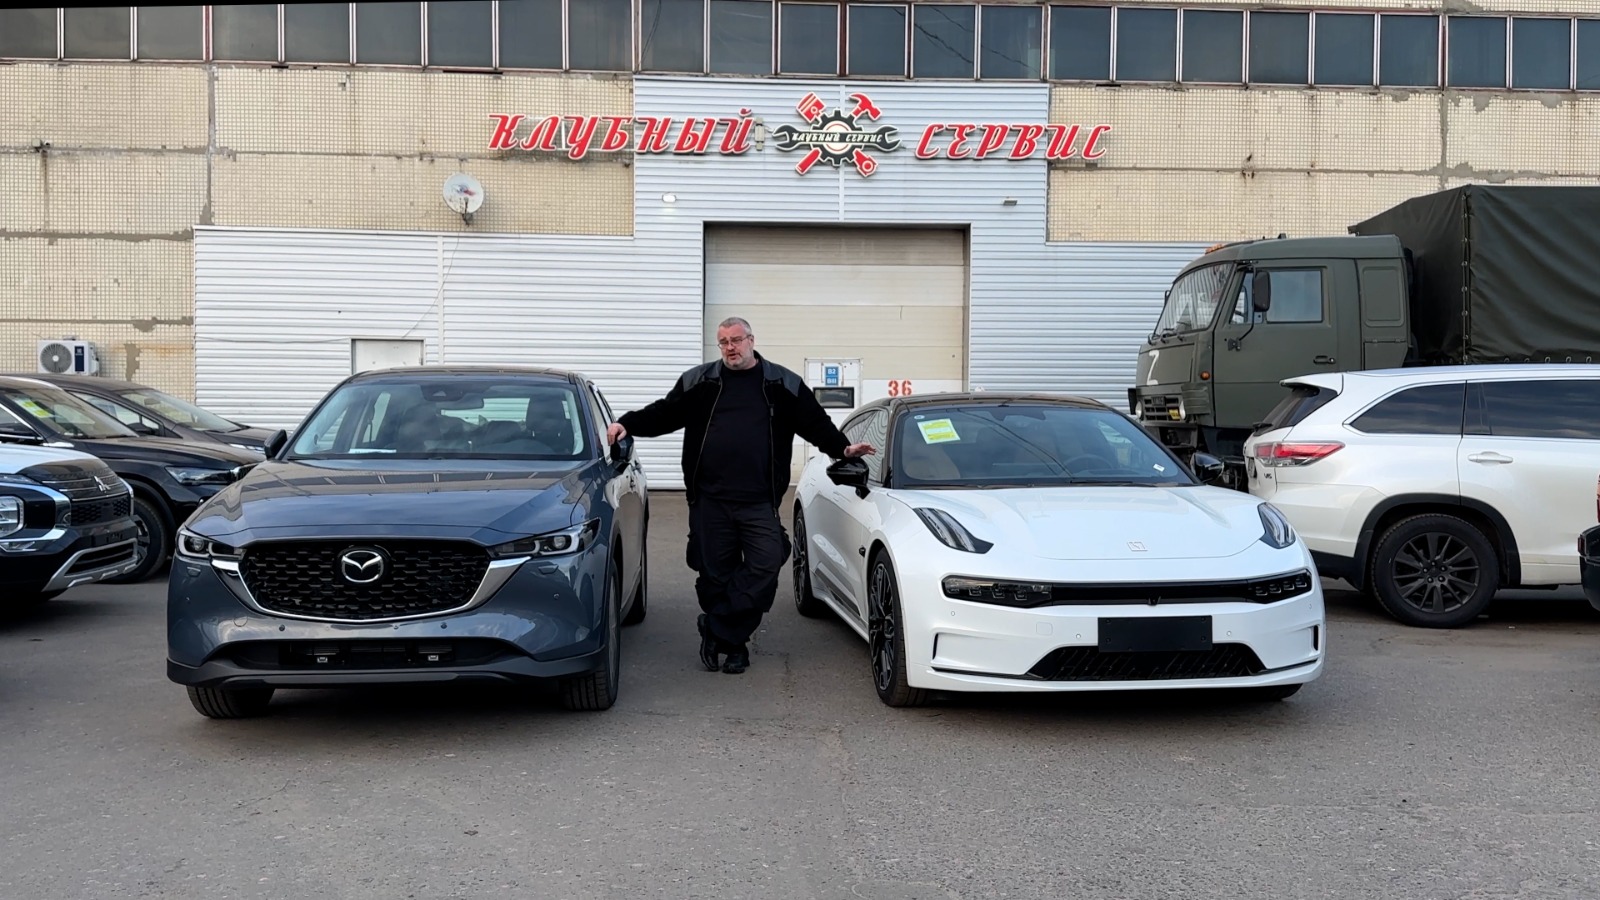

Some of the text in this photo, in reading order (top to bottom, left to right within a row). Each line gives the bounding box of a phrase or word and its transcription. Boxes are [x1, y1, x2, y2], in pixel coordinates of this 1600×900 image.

[488, 109, 1112, 160] КЛУБНЫЙ СЕРВИС
[791, 132, 883, 142] КЛУБНЫЙ СЕРВИС
[1147, 350, 1160, 386] Z
[888, 380, 912, 397] 36
